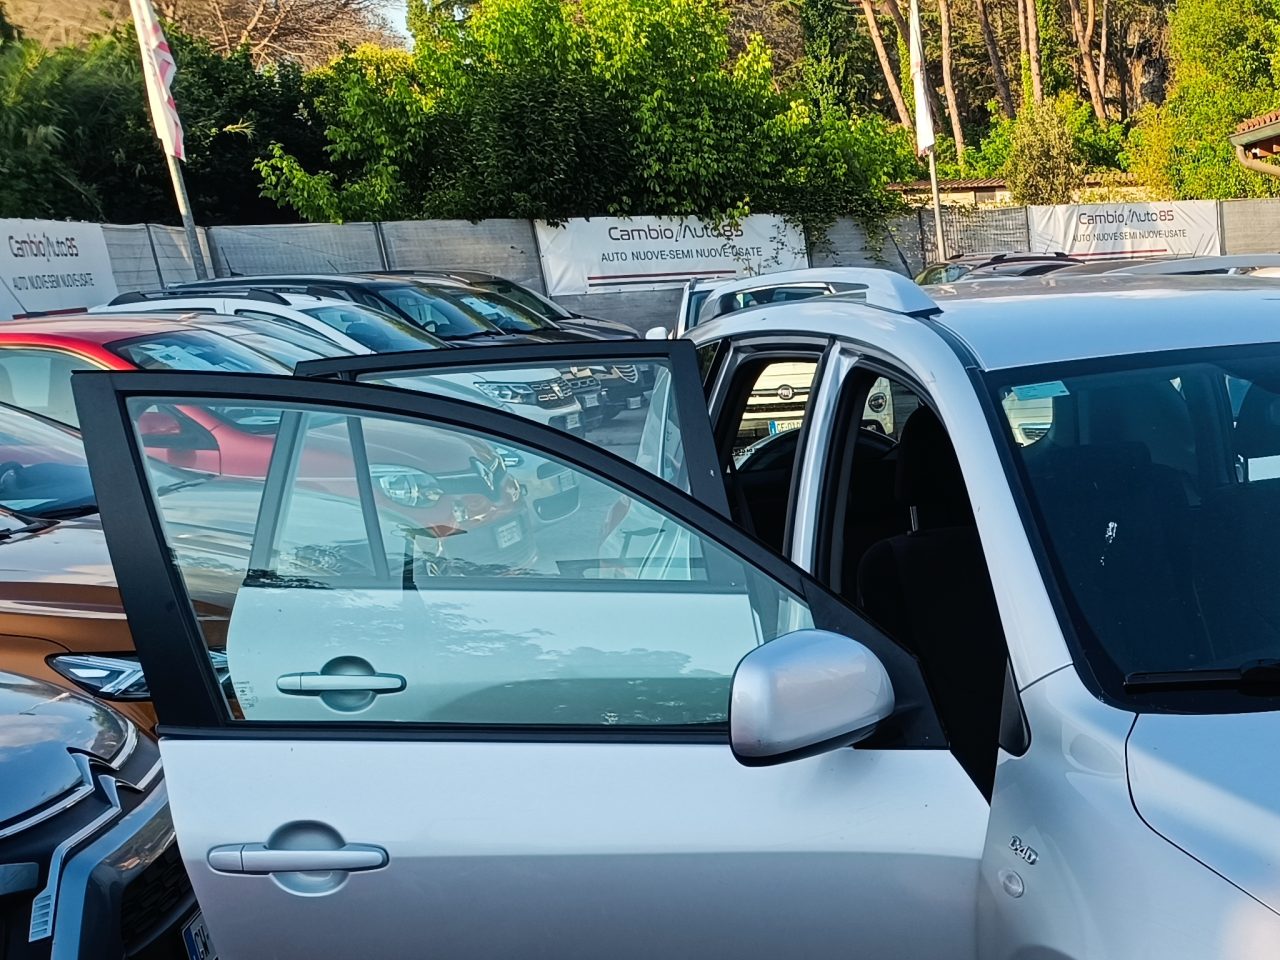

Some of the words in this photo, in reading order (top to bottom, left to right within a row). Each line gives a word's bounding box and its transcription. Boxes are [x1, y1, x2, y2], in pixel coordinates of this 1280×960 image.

[1073, 234, 1091, 243] AUTO
[601, 252, 628, 262] AUTO
[631, 249, 694, 261] NUOVE-SEMI
[696, 247, 763, 258] NUOVE-USATE
